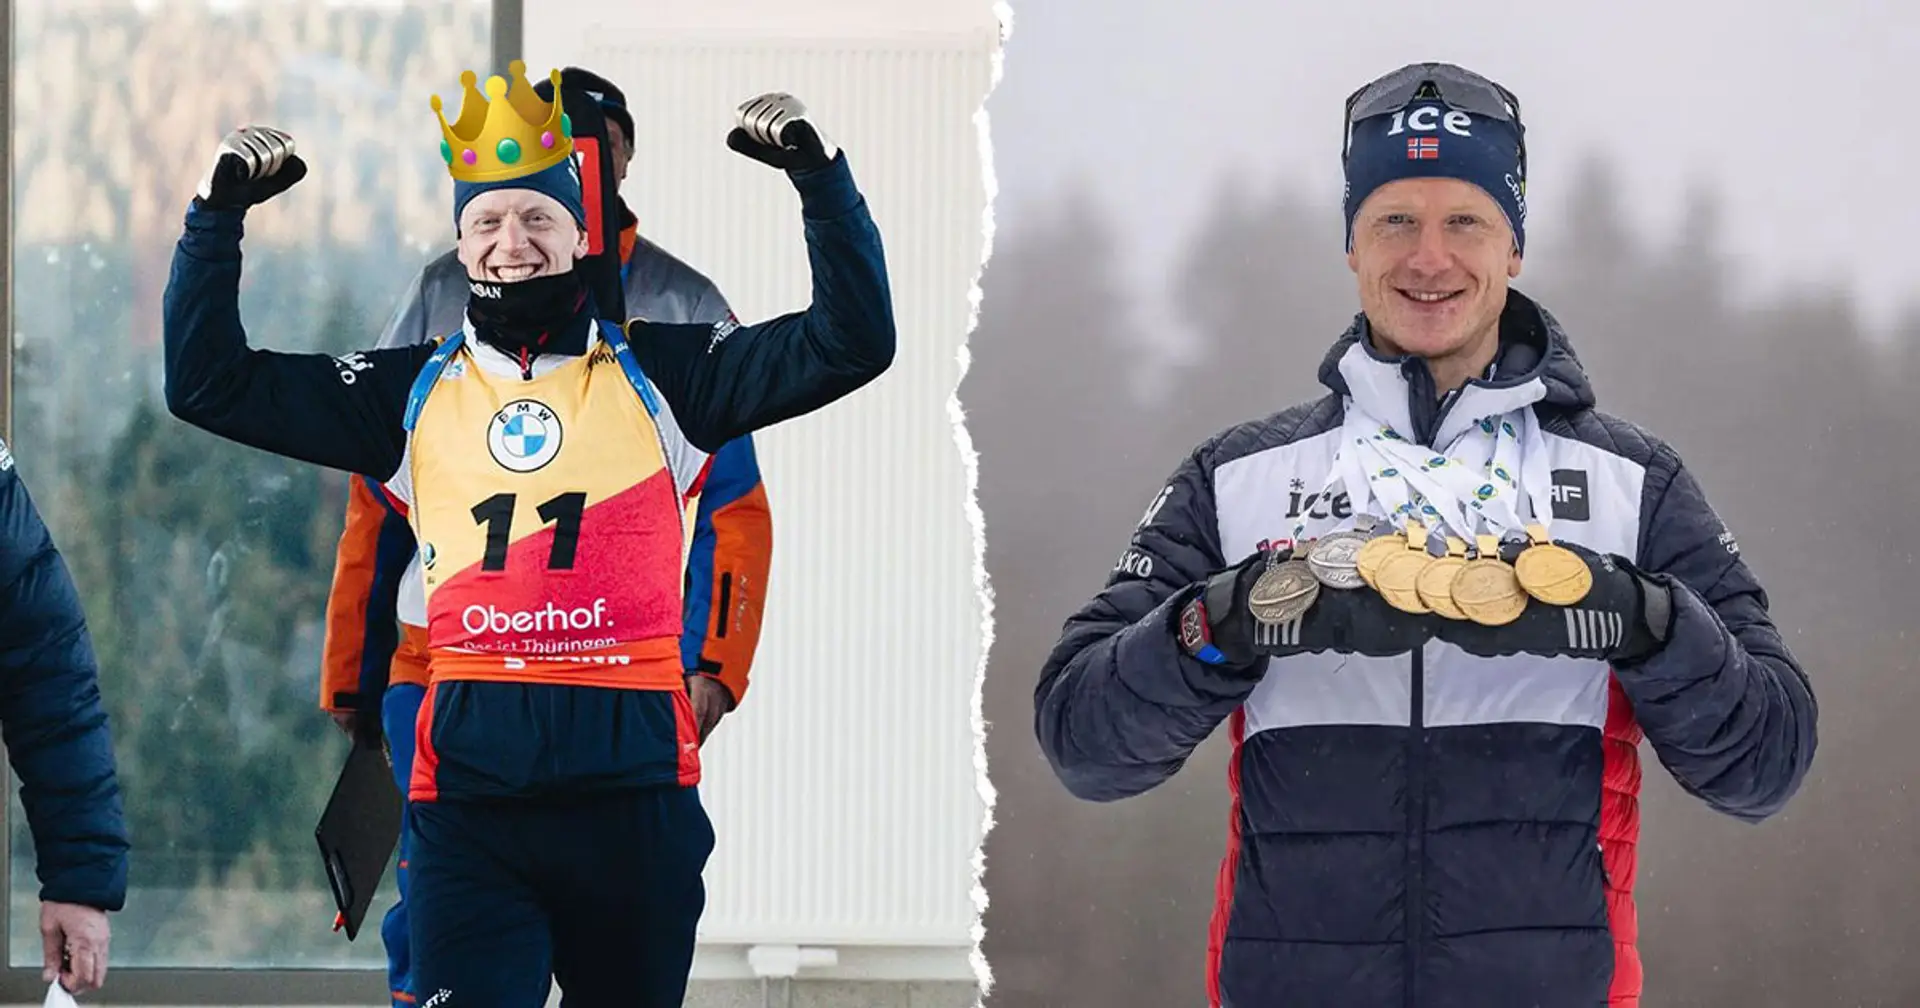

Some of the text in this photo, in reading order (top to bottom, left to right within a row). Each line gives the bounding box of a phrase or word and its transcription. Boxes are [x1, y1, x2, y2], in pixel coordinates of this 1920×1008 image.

[1387, 106, 1472, 137] ice
[498, 403, 552, 425] BMW
[470, 491, 588, 572] 11
[462, 598, 615, 635] Oberhof.
